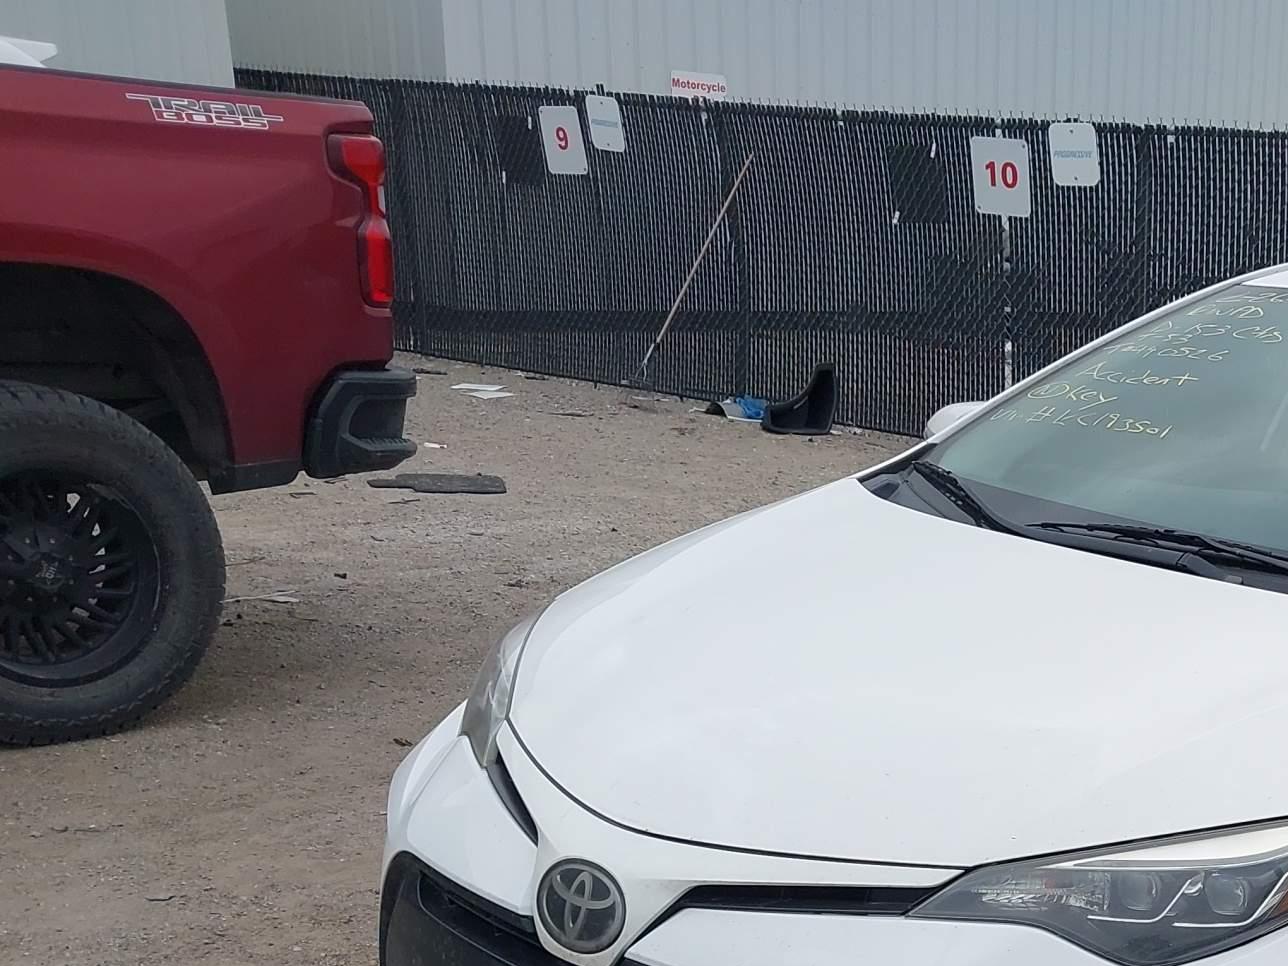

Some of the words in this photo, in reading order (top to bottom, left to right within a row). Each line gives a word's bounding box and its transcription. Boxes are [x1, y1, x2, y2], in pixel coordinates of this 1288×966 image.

[671, 77, 726, 93] Motorcycle
[125, 93, 284, 121] TRAIL
[153, 109, 269, 130] BOSS
[555, 126, 569, 150] 9
[985, 161, 1018, 189] 10
[1075, 361, 1200, 386] Accident
